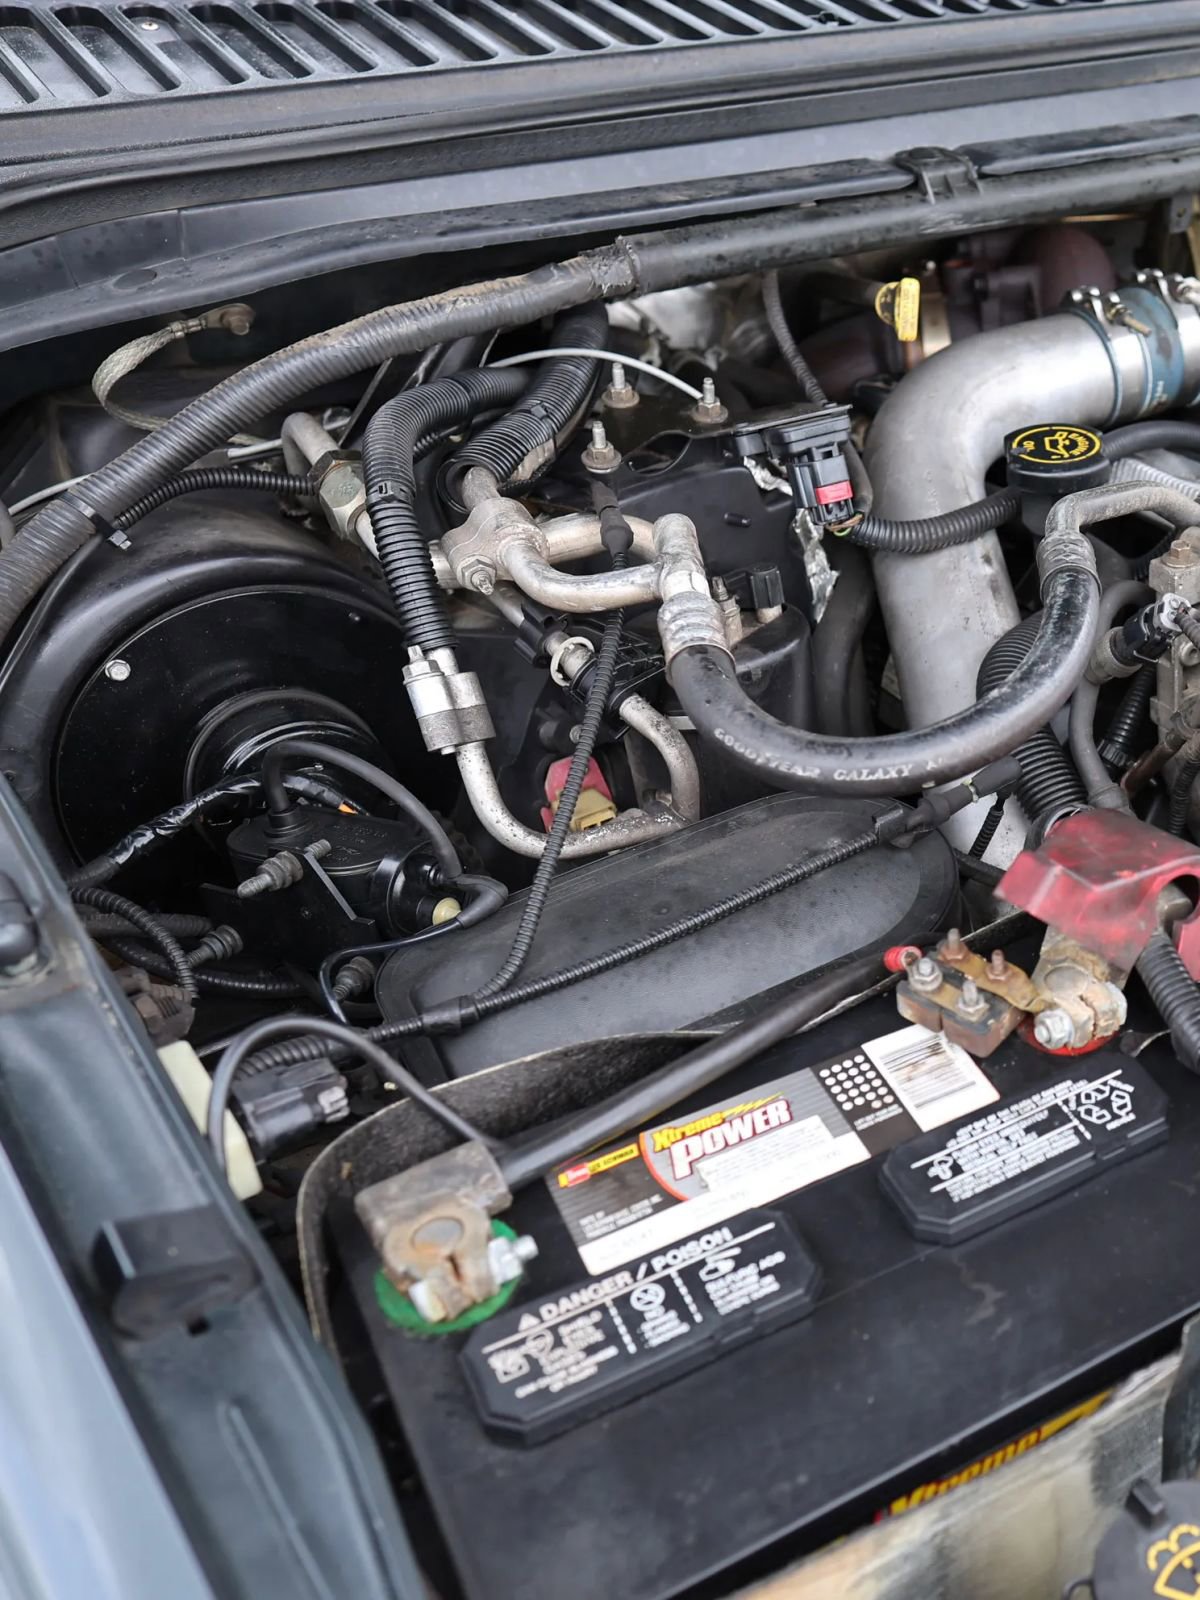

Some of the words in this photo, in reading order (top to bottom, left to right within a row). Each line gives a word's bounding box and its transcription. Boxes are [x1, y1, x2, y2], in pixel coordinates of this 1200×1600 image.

[714, 726, 821, 779] GOODYEAR
[833, 763, 914, 781] GALAXY
[652, 1110, 726, 1154] Xtreme
[668, 1098, 794, 1182] POWER
[538, 1269, 634, 1322] DANGER
[650, 1225, 733, 1273] POISON
